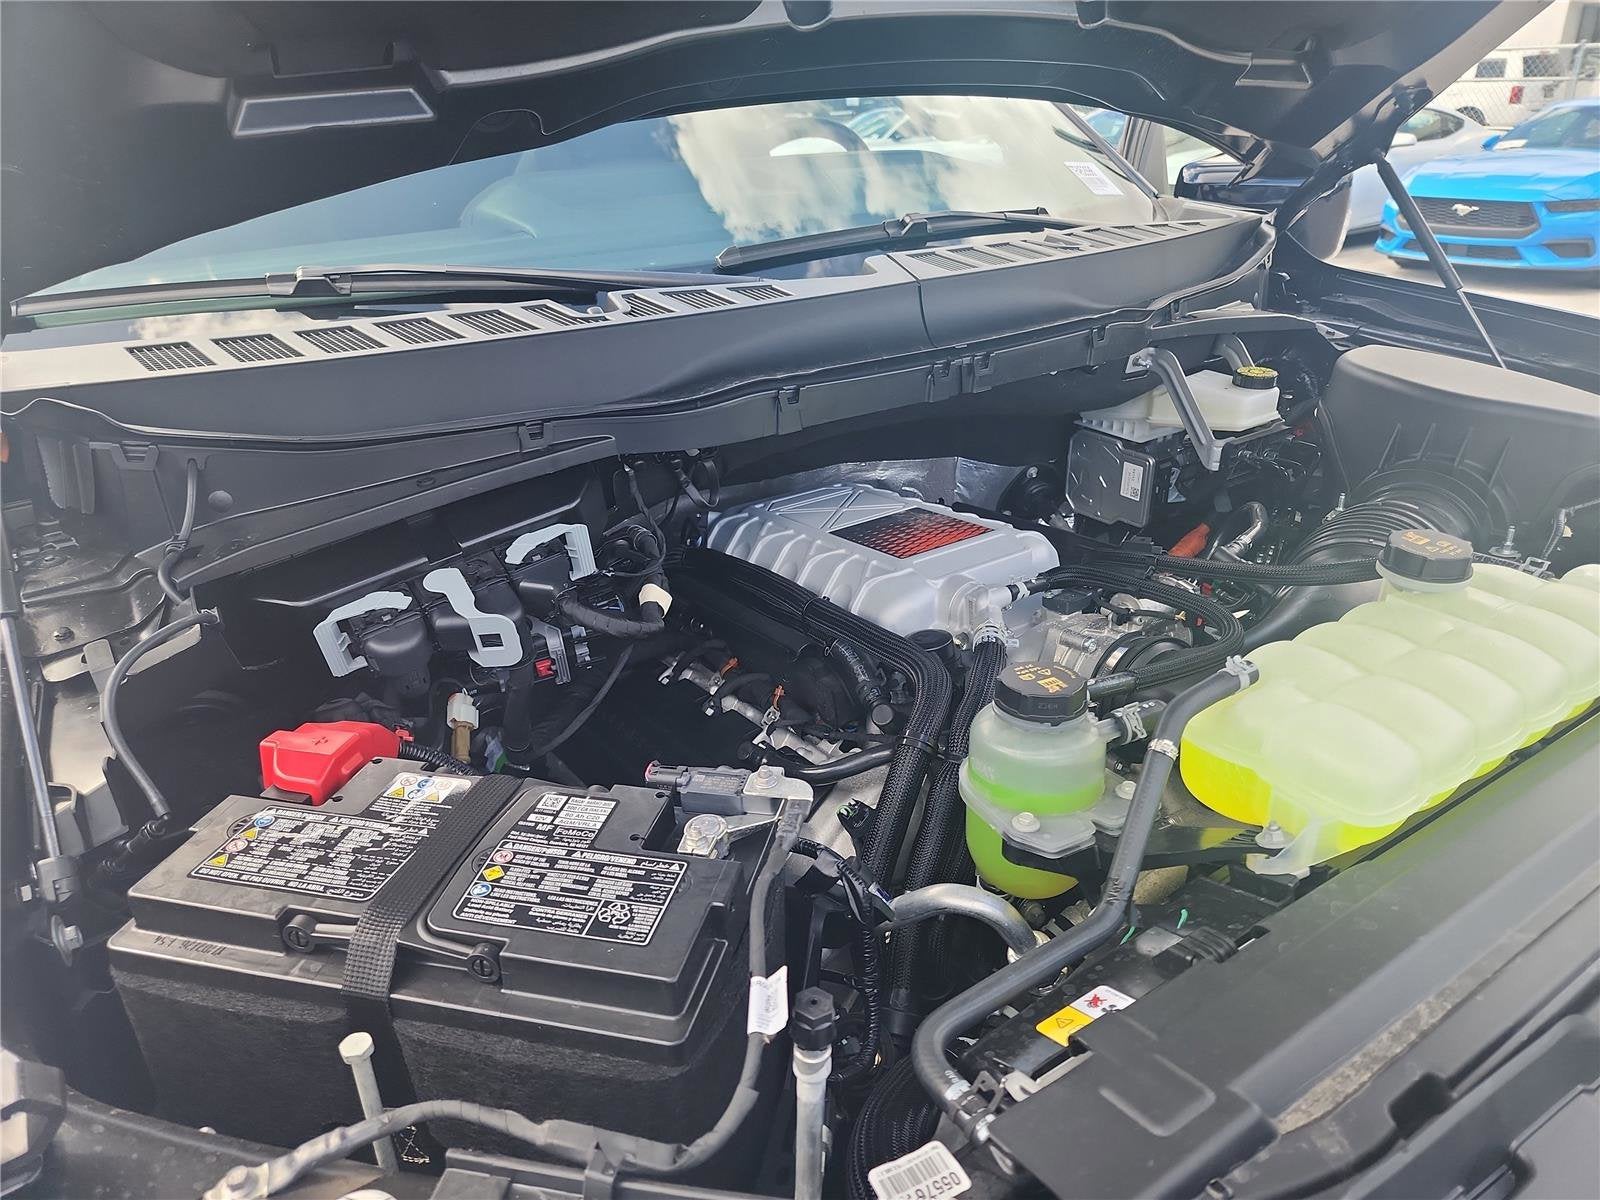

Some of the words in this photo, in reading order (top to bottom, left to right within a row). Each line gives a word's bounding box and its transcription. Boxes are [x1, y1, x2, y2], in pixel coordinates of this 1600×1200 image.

[535, 824, 555, 832] MF
[556, 827, 595, 839] FoMoCo
[512, 844, 568, 856] DANGER/POISON
[580, 853, 638, 865] PELIGRO/VENENO
